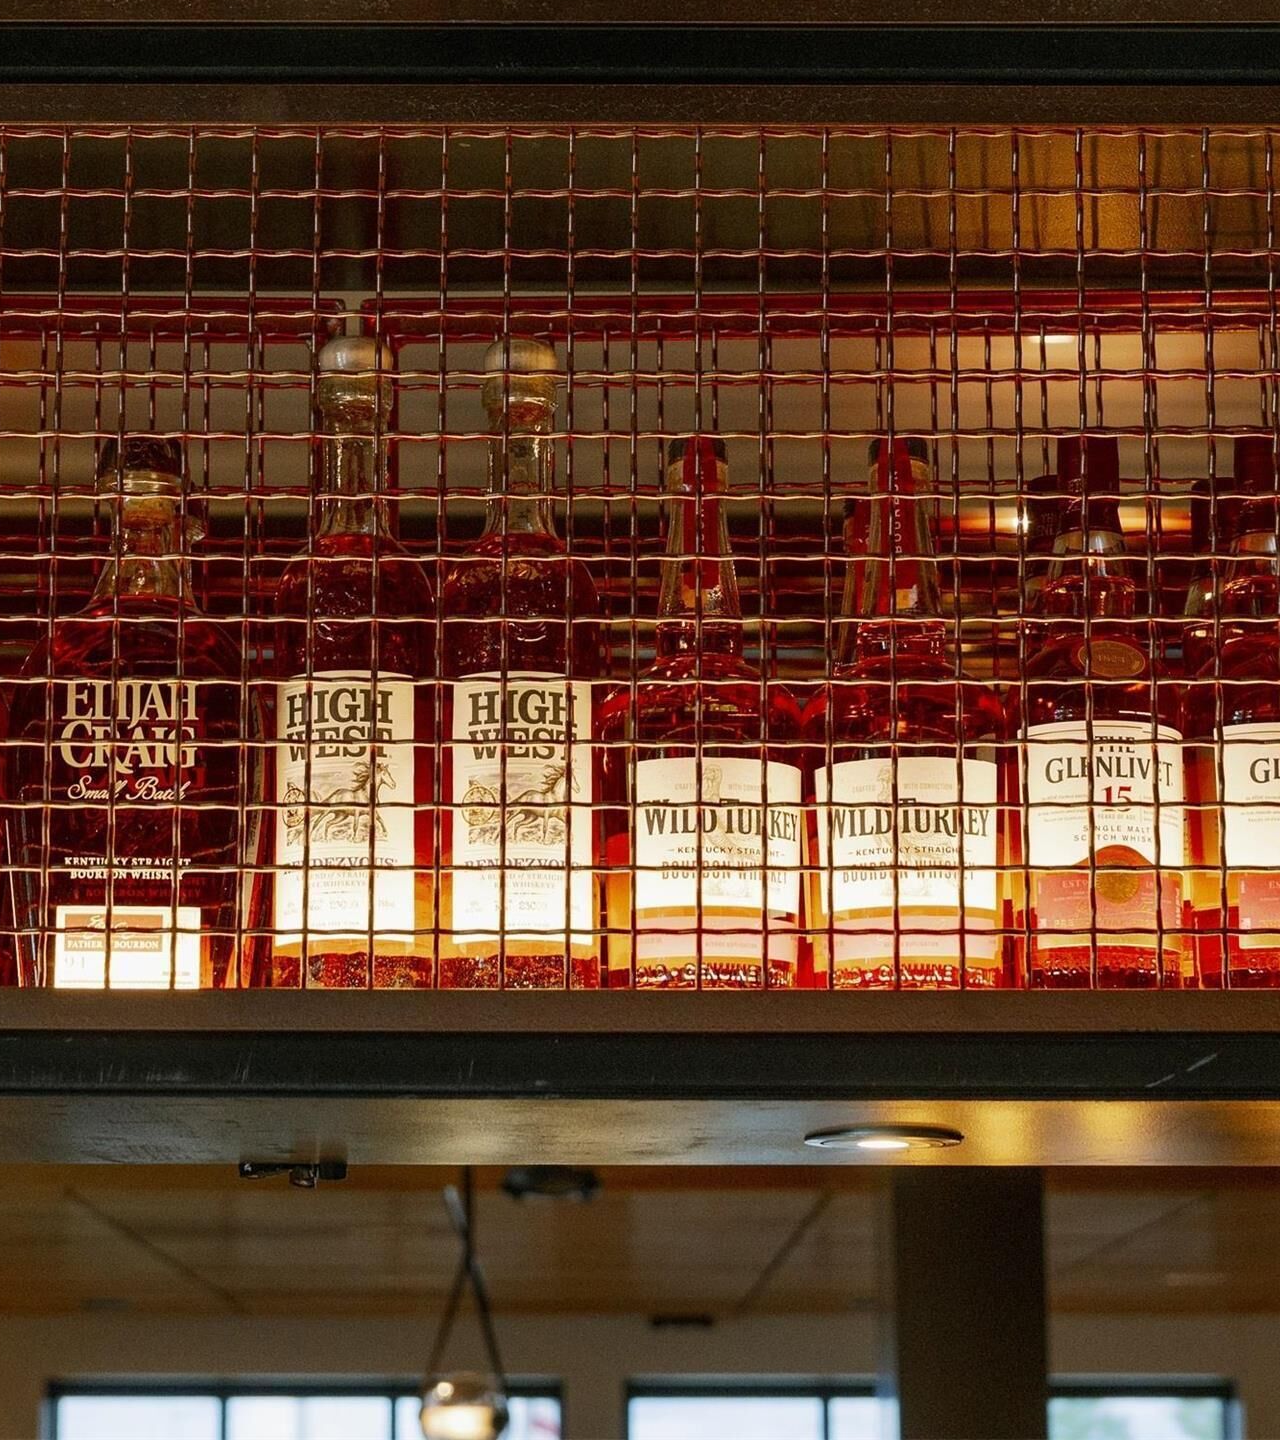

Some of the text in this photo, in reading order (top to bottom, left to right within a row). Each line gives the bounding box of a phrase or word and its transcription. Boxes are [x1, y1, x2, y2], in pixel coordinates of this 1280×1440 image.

[286, 688, 394, 729] HIGH
[467, 689, 578, 729] HIGH
[60, 720, 197, 773] CRAIG
[286, 726, 393, 762] WEST
[467, 726, 578, 761] WEST
[1094, 735, 1136, 754] THE
[67, 775, 126, 800] Small
[1101, 786, 1132, 812] 15
[642, 799, 718, 836] WILD
[1082, 824, 1151, 835] SNGLE MALT
[677, 846, 733, 855] KENUCKY
[1073, 834, 1152, 844] SCTCH WHISK
[131, 870, 185, 880] WHISKY
[67, 940, 103, 949] FATHER
